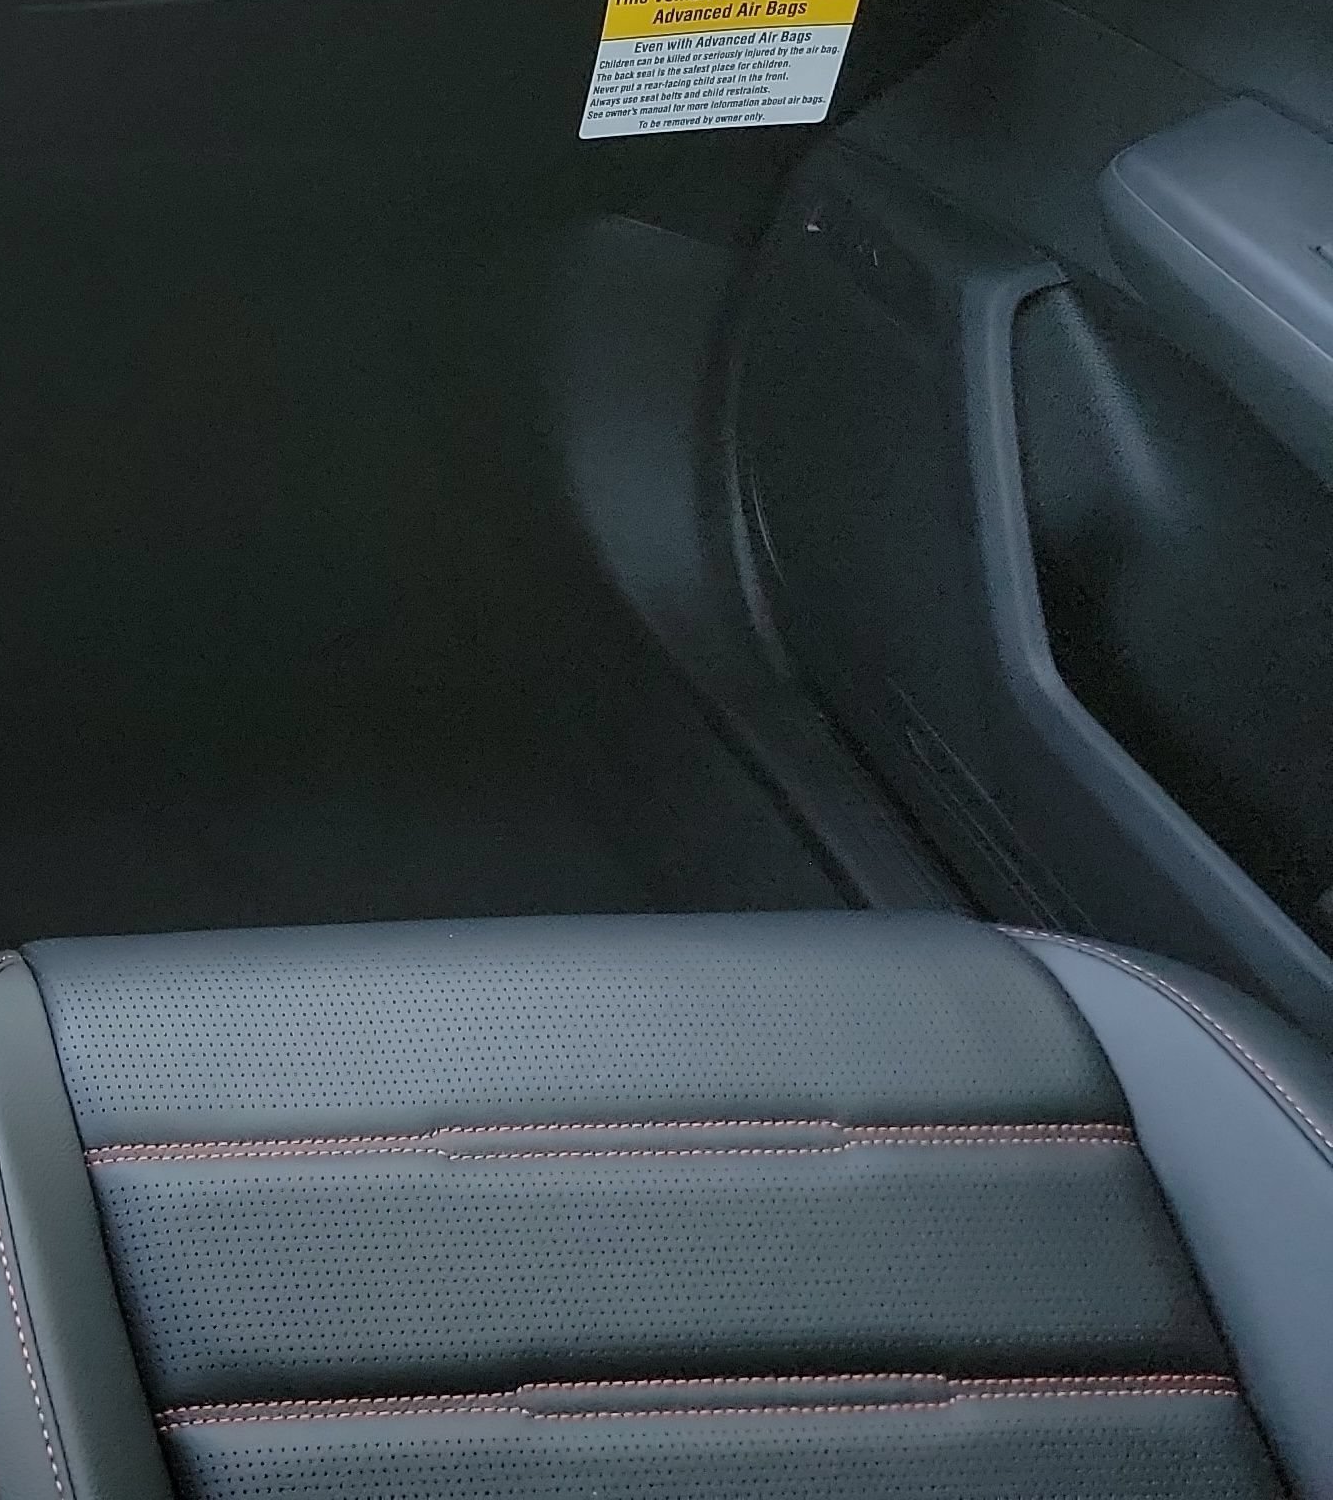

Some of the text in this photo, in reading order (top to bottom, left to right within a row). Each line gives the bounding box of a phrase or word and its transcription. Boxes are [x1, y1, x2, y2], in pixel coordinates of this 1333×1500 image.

[652, 0, 808, 25] Advanced Air Bags
[634, 30, 813, 54] Even with Advanced Air Bags
[599, 44, 840, 70] Children can be killed or seriously injured by the air bag.
[596, 59, 792, 82] The back seat is the safest place for children.
[593, 85, 618, 96] Never
[620, 83, 634, 94] put
[644, 78, 691, 91] rear-facing
[693, 75, 714, 86] child
[717, 74, 736, 84] seat
[738, 73, 746, 83] in
[748, 72, 763, 82] the
[765, 71, 789, 81] front.
[587, 110, 603, 120] See
[605, 106, 638, 118] owner's
[639, 104, 671, 115] manual
[673, 102, 685, 112] for
[687, 101, 709, 111] more
[711, 98, 759, 109] information
[761, 96, 786, 106] about
[787, 95, 801, 105] air
[590, 85, 771, 108] Always use seat belts and child restraints.
[638, 120, 648, 129] To
[650, 119, 661, 129] be
[663, 116, 701, 127] removed
[702, 115, 713, 125] by
[715, 113, 743, 123] owner
